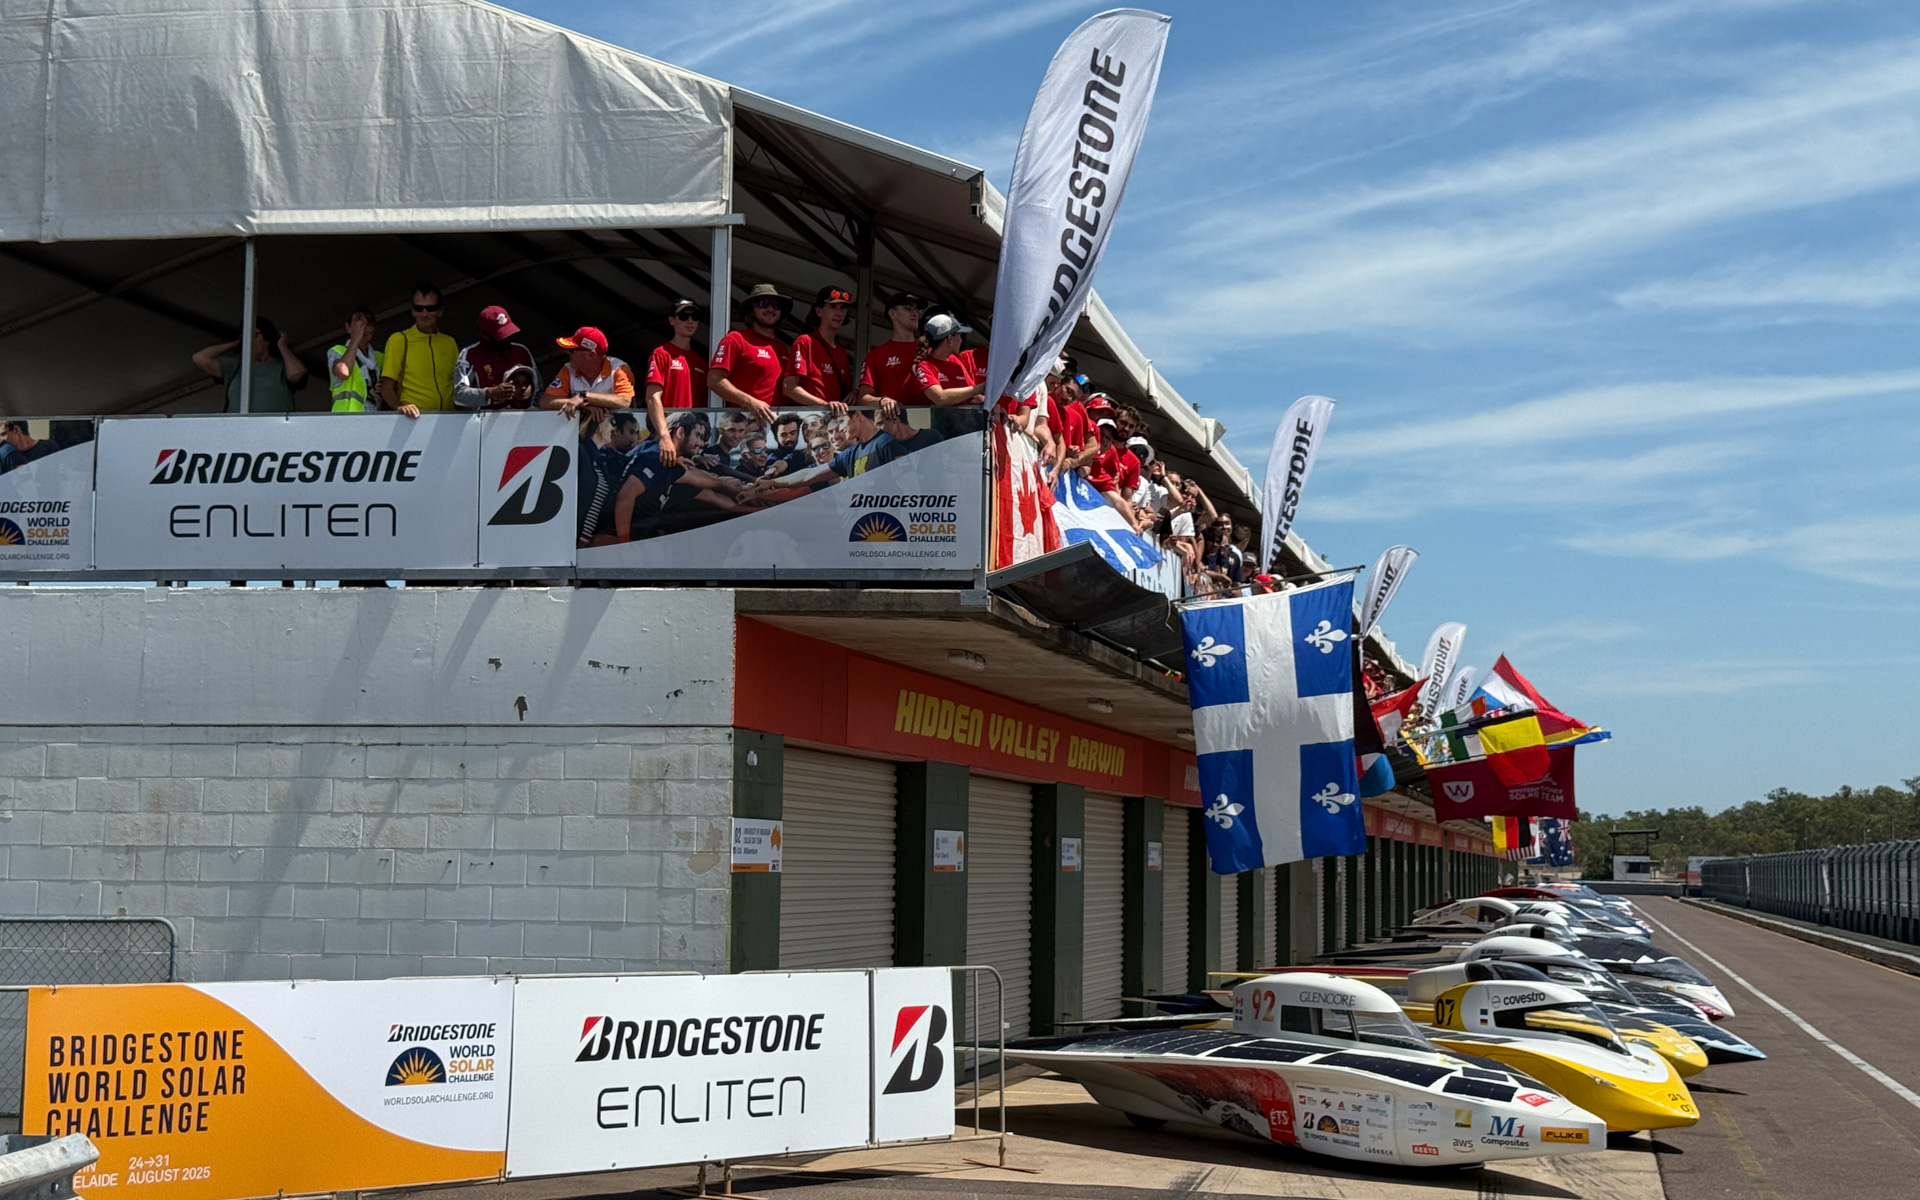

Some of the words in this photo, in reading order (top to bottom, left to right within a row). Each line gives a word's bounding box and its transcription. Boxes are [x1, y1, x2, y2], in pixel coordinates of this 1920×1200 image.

[1009, 47, 1126, 384] IDGESTONE
[150, 448, 423, 485] BRIDGESTONE
[0, 501, 71, 514] DGESTONE
[849, 494, 957, 508] BRIDGESTONE
[27, 517, 70, 528] WORLD
[169, 503, 397, 538] ENLITEN
[909, 512, 957, 523] WORLD
[27, 528, 70, 538] SOLAR
[909, 523, 957, 534] SOLAR
[849, 550, 957, 558] WORLDSOLARCHALLENGE.ORG
[894, 689, 984, 747] HIDDEN
[988, 713, 1061, 763] VALLEY
[1066, 735, 1126, 777] DARWIN
[1541, 792, 1564, 803] TEAM
[1252, 988, 1276, 1022] 92
[1299, 991, 1356, 1007] GLENCORE
[1503, 991, 1546, 1005] covestro
[1435, 998, 1455, 1026] 07
[387, 1022, 496, 1043] BRIDGESTONE
[574, 1013, 825, 1062] BRIDGESTONE
[50, 1030, 244, 1067] BRIDGESTONE
[449, 1044, 496, 1059] WORLD
[448, 1058, 495, 1073] SOLAR
[49, 1069, 147, 1104] WORLD
[161, 1065, 246, 1099] SOLAR
[448, 1073, 495, 1083] CHALLENGE
[383, 1091, 494, 1106] WORLDSOLARCHALLENGE.ORG
[597, 1075, 806, 1130] ENLITEN
[46, 1101, 210, 1139] CHALLENGE
[1340, 1118, 1360, 1126] WORLD
[1486, 1115, 1526, 1138] M1
[1340, 1125, 1360, 1133] SOLAR
[1546, 1131, 1584, 1140] FLUKE
[1310, 1133, 1329, 1142] TOYOTA
[1452, 1138, 1474, 1148] aws
[1480, 1136, 1530, 1148] Composites
[126, 1168, 180, 1185] AUGUST
[182, 1166, 211, 1181] 2025
